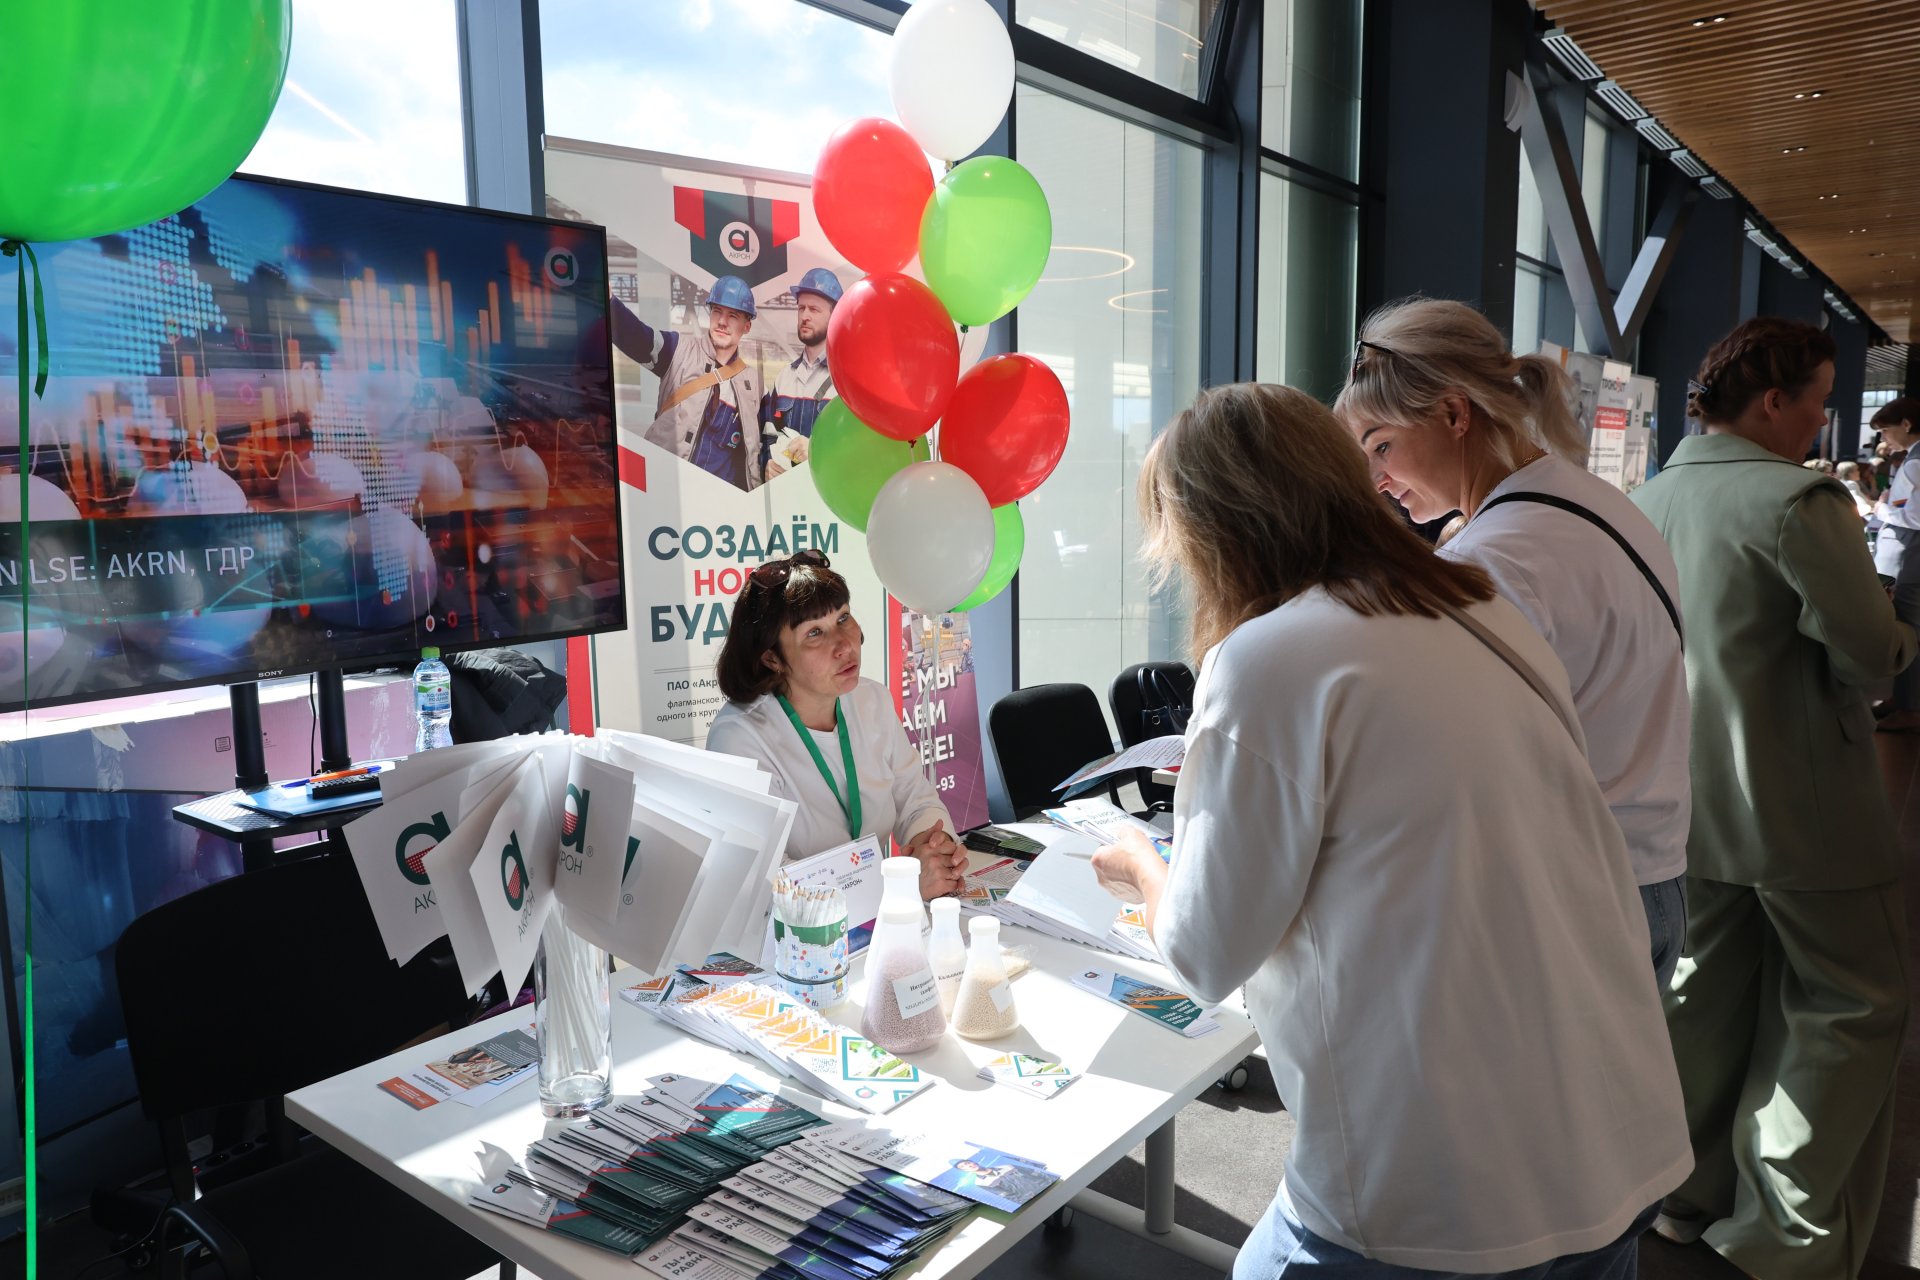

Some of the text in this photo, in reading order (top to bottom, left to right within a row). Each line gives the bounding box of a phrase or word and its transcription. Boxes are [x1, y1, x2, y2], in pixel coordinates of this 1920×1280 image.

[648, 515, 839, 563] СОЗДАЁМ
[29, 555, 97, 584] LSE:
[107, 549, 196, 579] AKRN,
[204, 546, 255, 575] ГДР
[258, 669, 284, 678] SONY
[667, 678, 719, 691] ПАО «Акр
[667, 696, 720, 710] флагманское
[656, 711, 686, 723] одного
[559, 851, 583, 876] РОН
[517, 890, 535, 943] АКРОН
[662, 1258, 680, 1270] ТЫ
